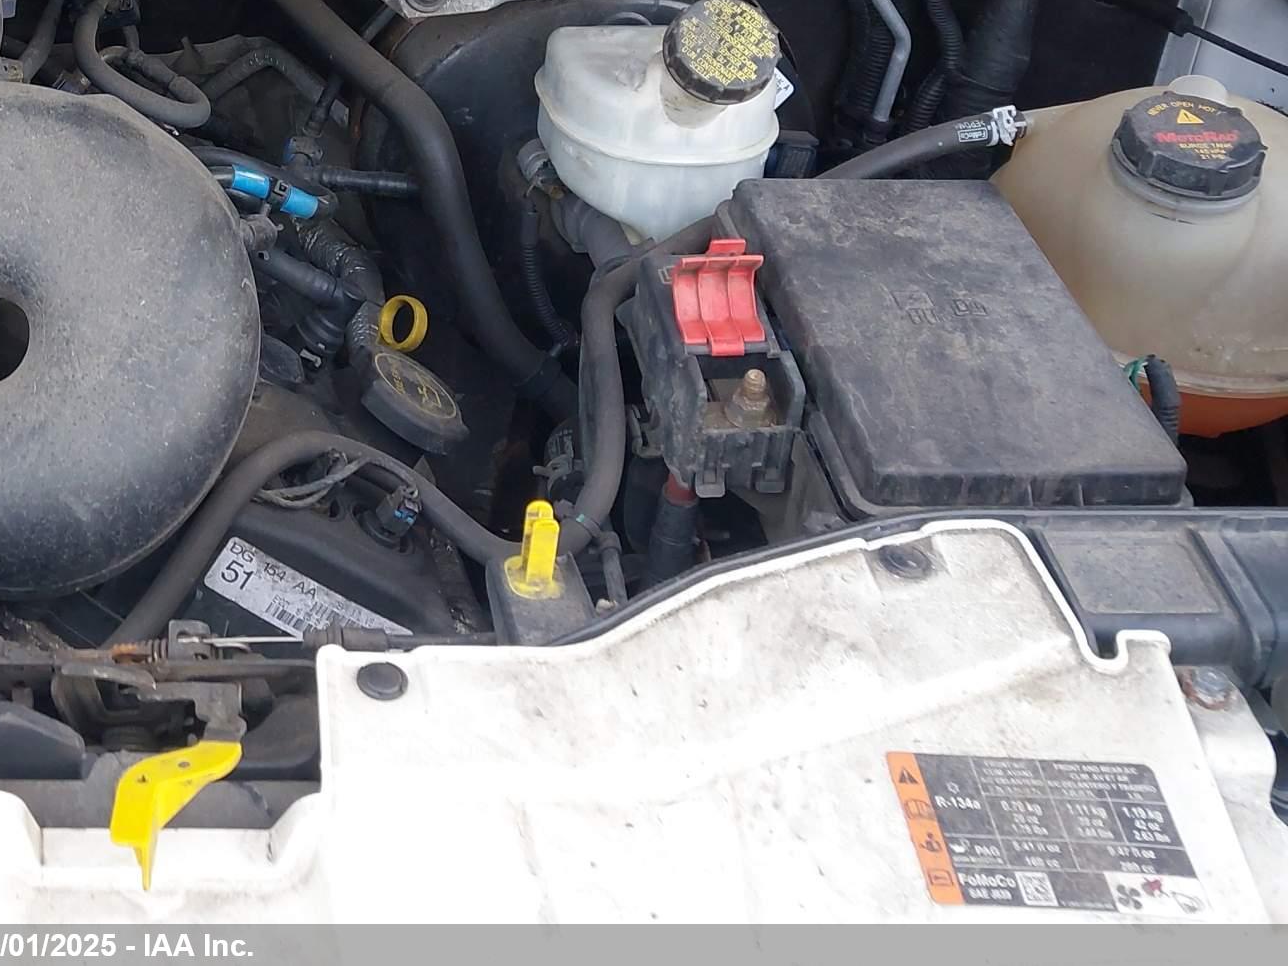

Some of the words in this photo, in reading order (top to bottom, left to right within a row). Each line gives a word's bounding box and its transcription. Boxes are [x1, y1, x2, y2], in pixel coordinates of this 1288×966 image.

[762, 28, 776, 41] CAP
[221, 560, 254, 590] 51
[293, 580, 318, 599] AA
[934, 795, 982, 810] R-134a
[957, 872, 1017, 888] FoMoCo
